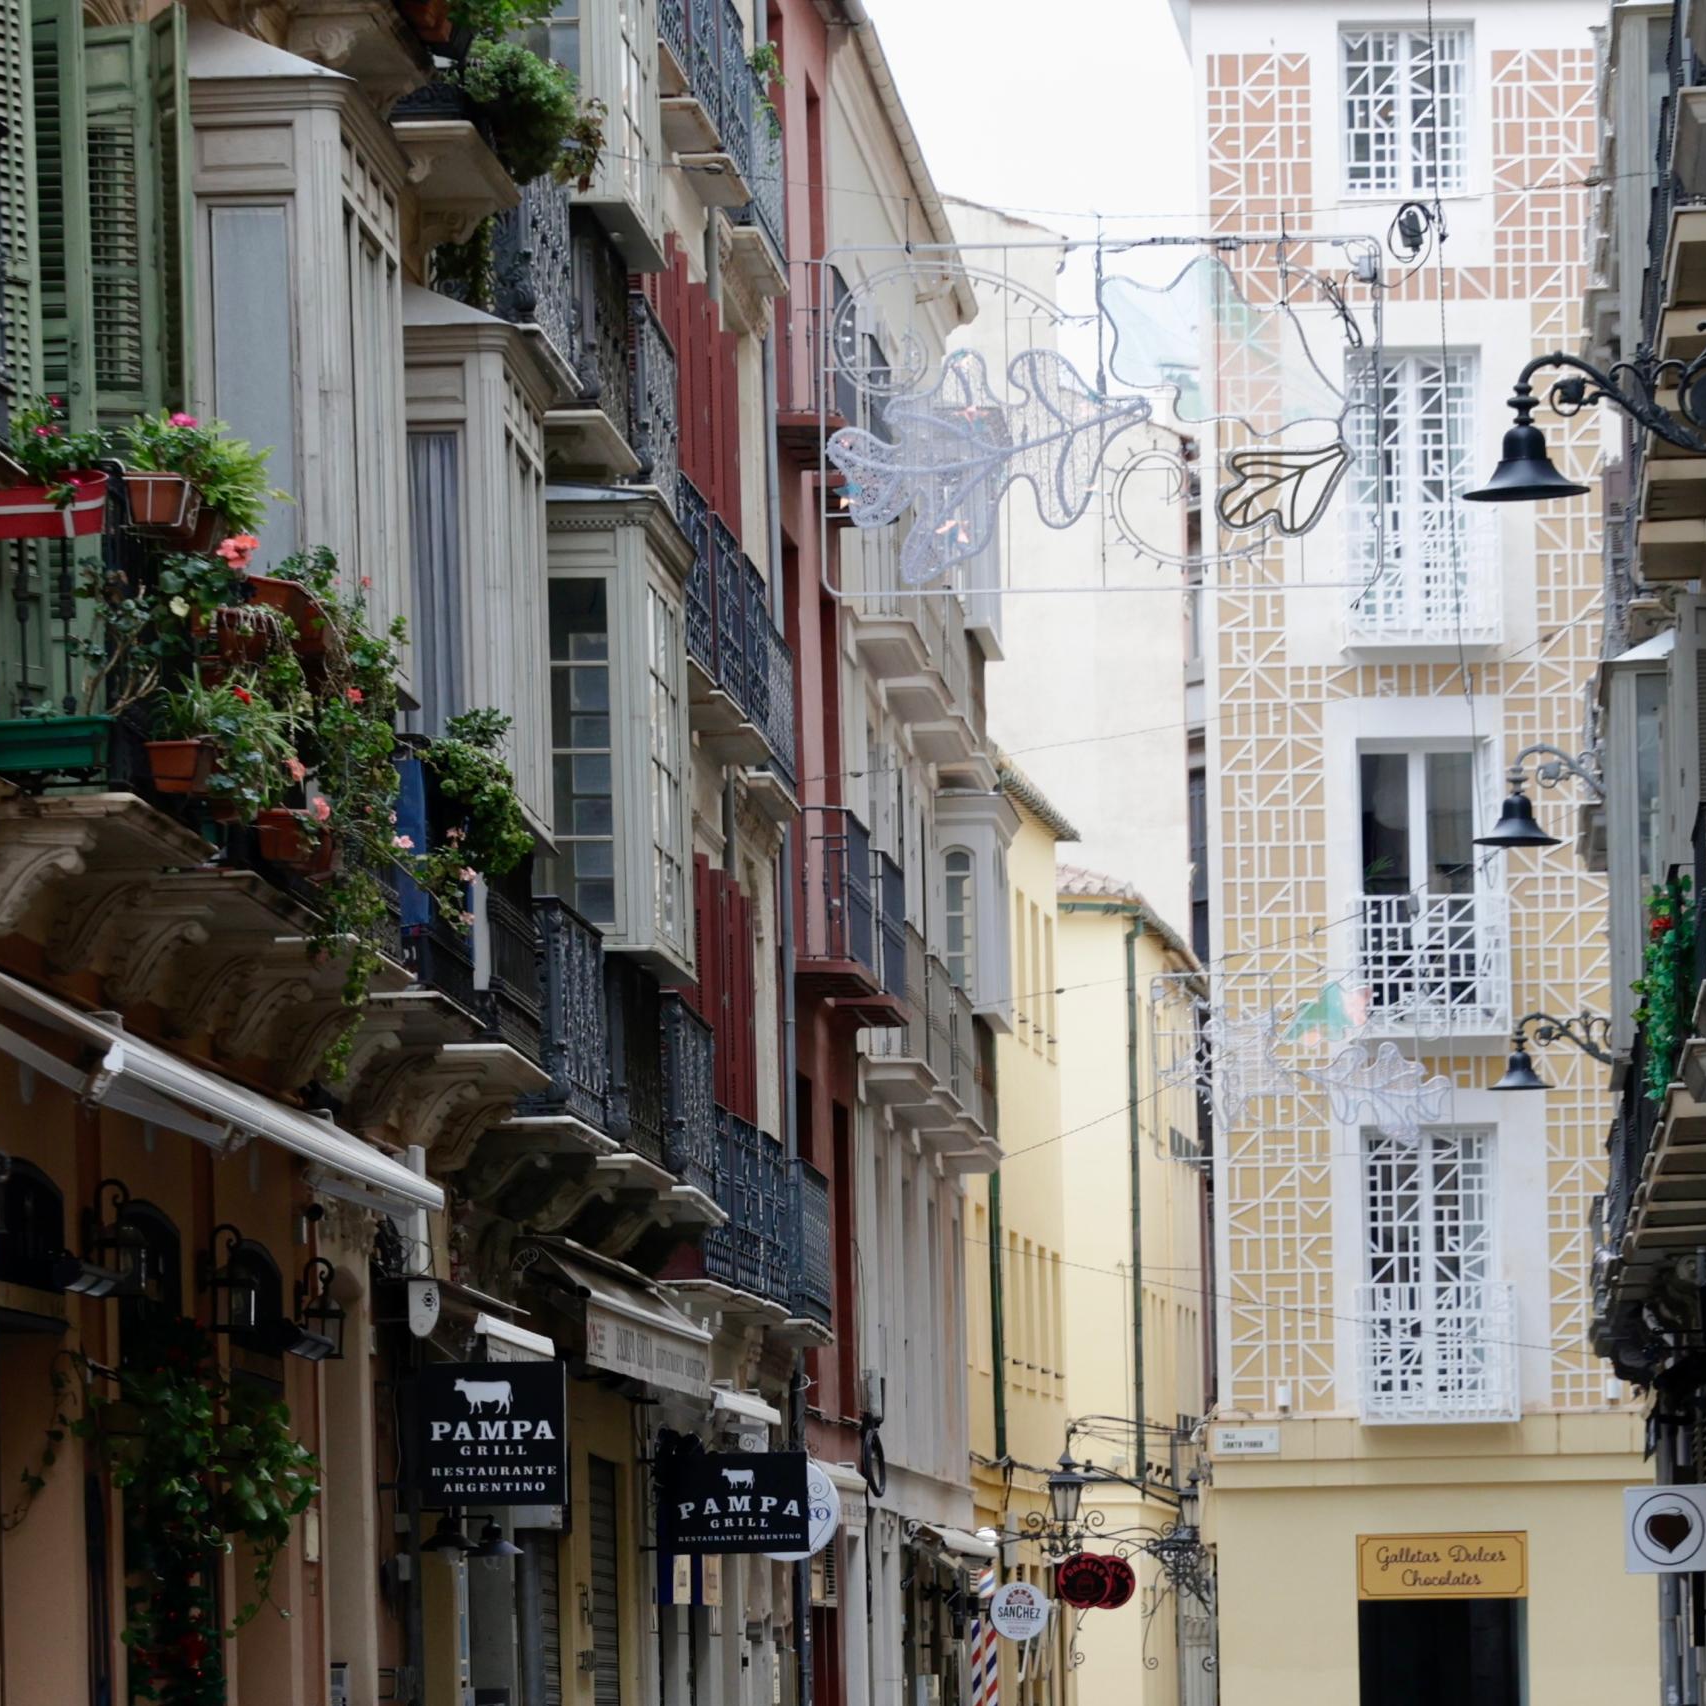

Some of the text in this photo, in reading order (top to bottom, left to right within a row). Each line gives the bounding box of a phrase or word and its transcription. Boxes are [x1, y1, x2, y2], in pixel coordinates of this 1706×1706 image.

[429, 1419, 557, 1442] PAMPA
[459, 1444, 528, 1457] GRILL
[430, 1465, 558, 1477] RESTAURANTE
[442, 1481, 546, 1493] ARGENTINO
[677, 1495, 802, 1521] PAMPA
[709, 1517, 769, 1530] GRILL
[677, 1532, 802, 1543] RESTAURANTE ARGENTINO
[1376, 1544, 1507, 1572] Galletas Dulces
[1401, 1568, 1483, 1587] Chocolates
